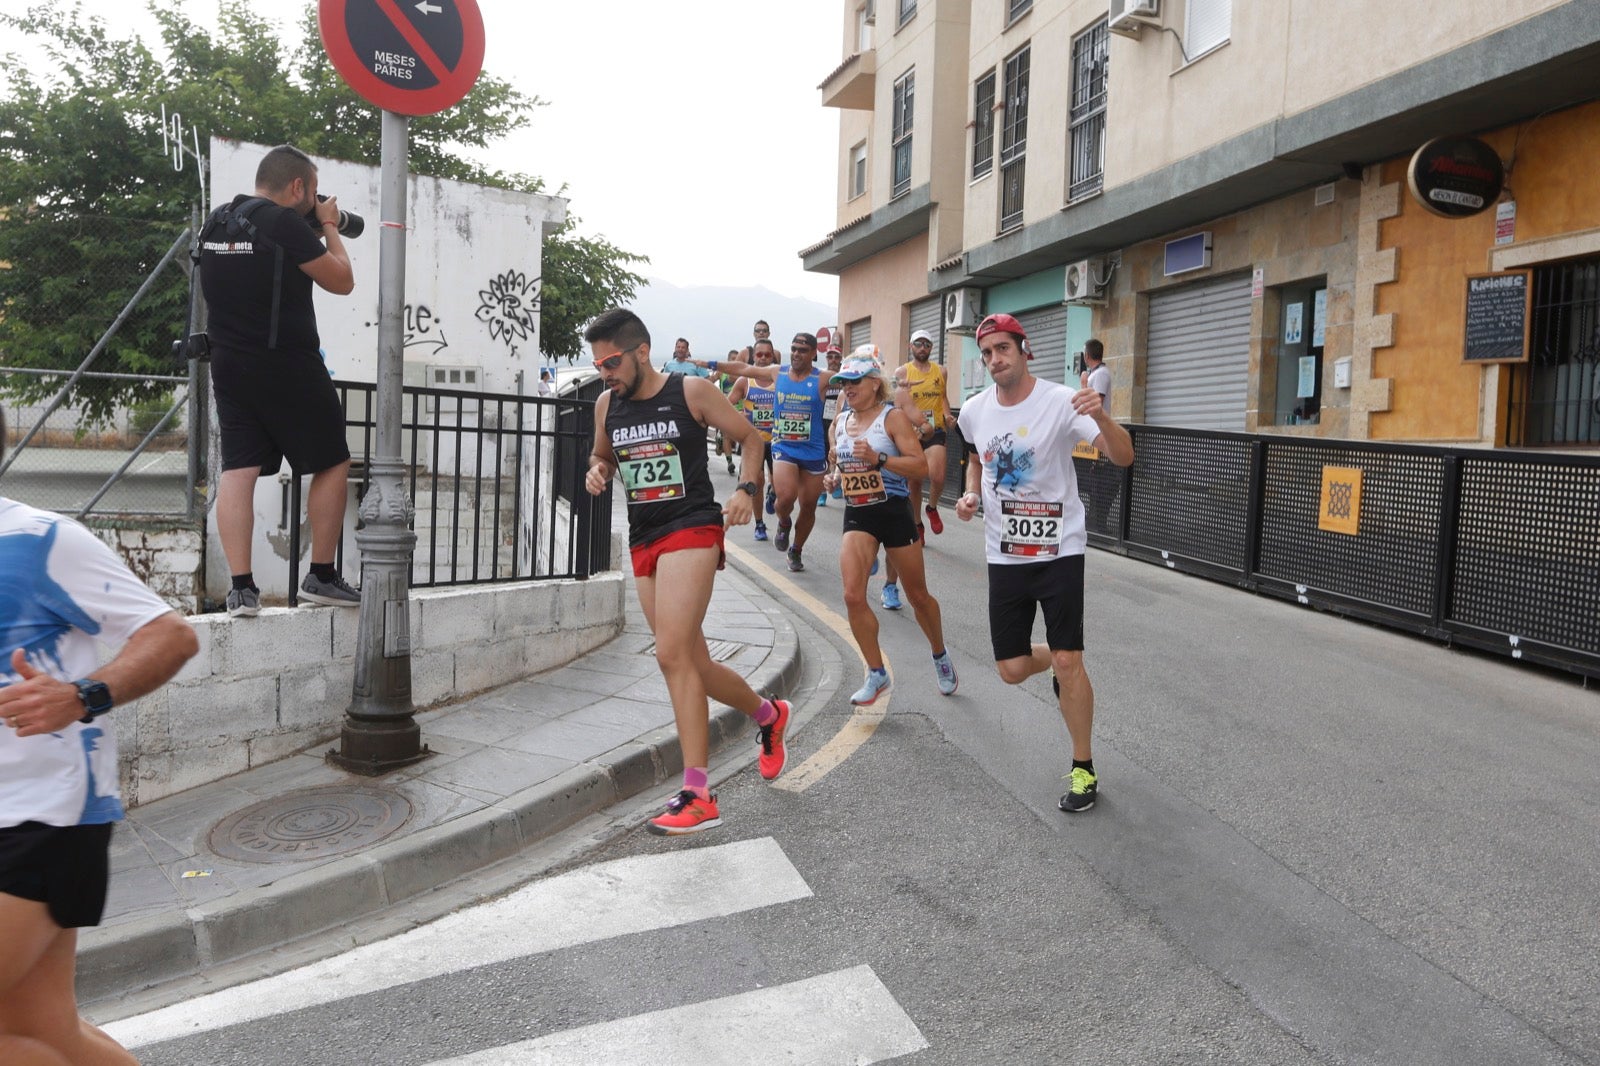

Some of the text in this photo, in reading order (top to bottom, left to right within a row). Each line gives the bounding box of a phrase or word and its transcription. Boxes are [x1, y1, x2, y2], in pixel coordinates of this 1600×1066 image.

[374, 50, 416, 68] MESES
[374, 64, 413, 80] PARES
[612, 420, 678, 442] GRANADA
[784, 420, 805, 432] 525
[629, 459, 672, 484] 732
[844, 474, 880, 491] 2268
[1007, 517, 1058, 539] 3032
